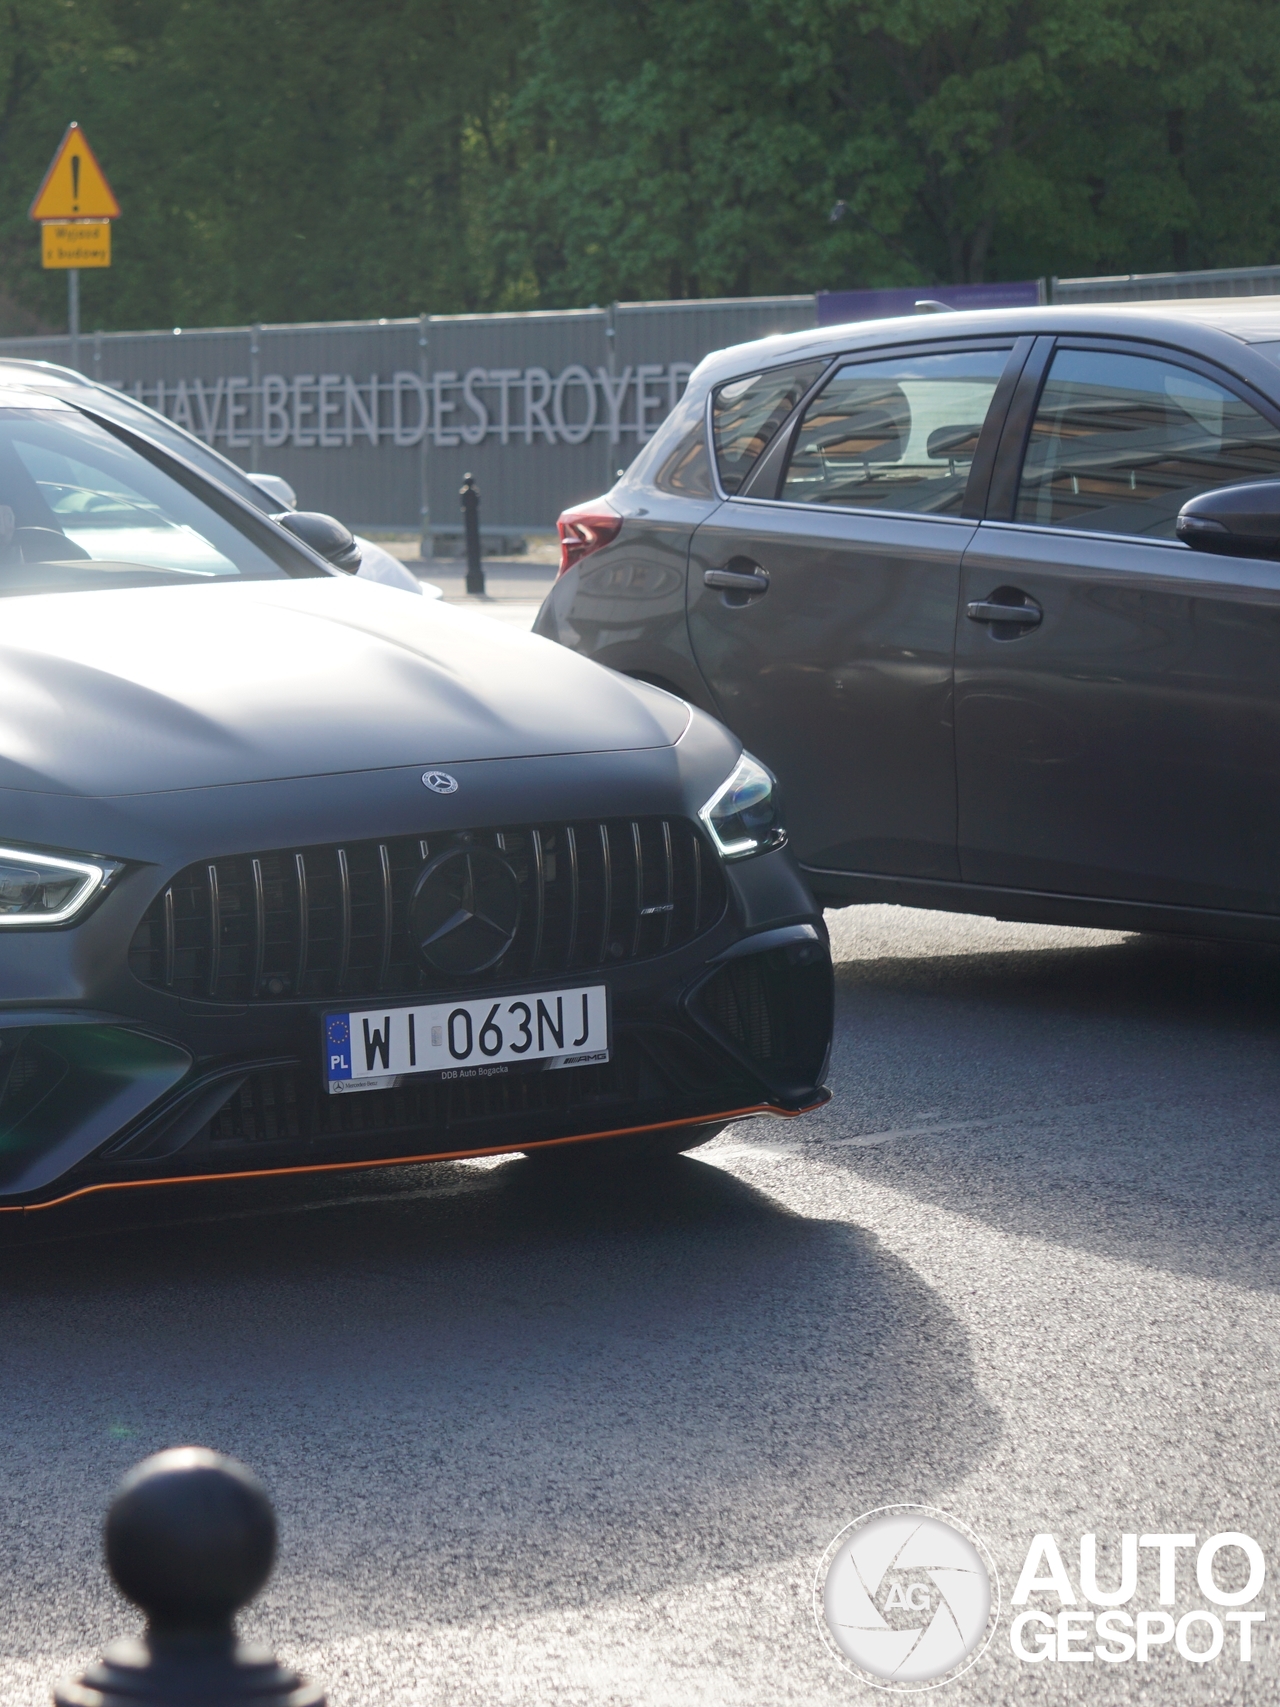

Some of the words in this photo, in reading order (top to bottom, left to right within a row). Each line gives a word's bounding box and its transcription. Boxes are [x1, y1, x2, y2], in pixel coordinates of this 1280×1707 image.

[263, 374, 378, 447] BEEN
[447, 993, 589, 1060] 063NJ
[330, 1054, 348, 1070] PL
[577, 1053, 607, 1062] AMG
[441, 1071, 458, 1080] DDB
[459, 1069, 477, 1078] Auto
[478, 1065, 509, 1077] Bogacka
